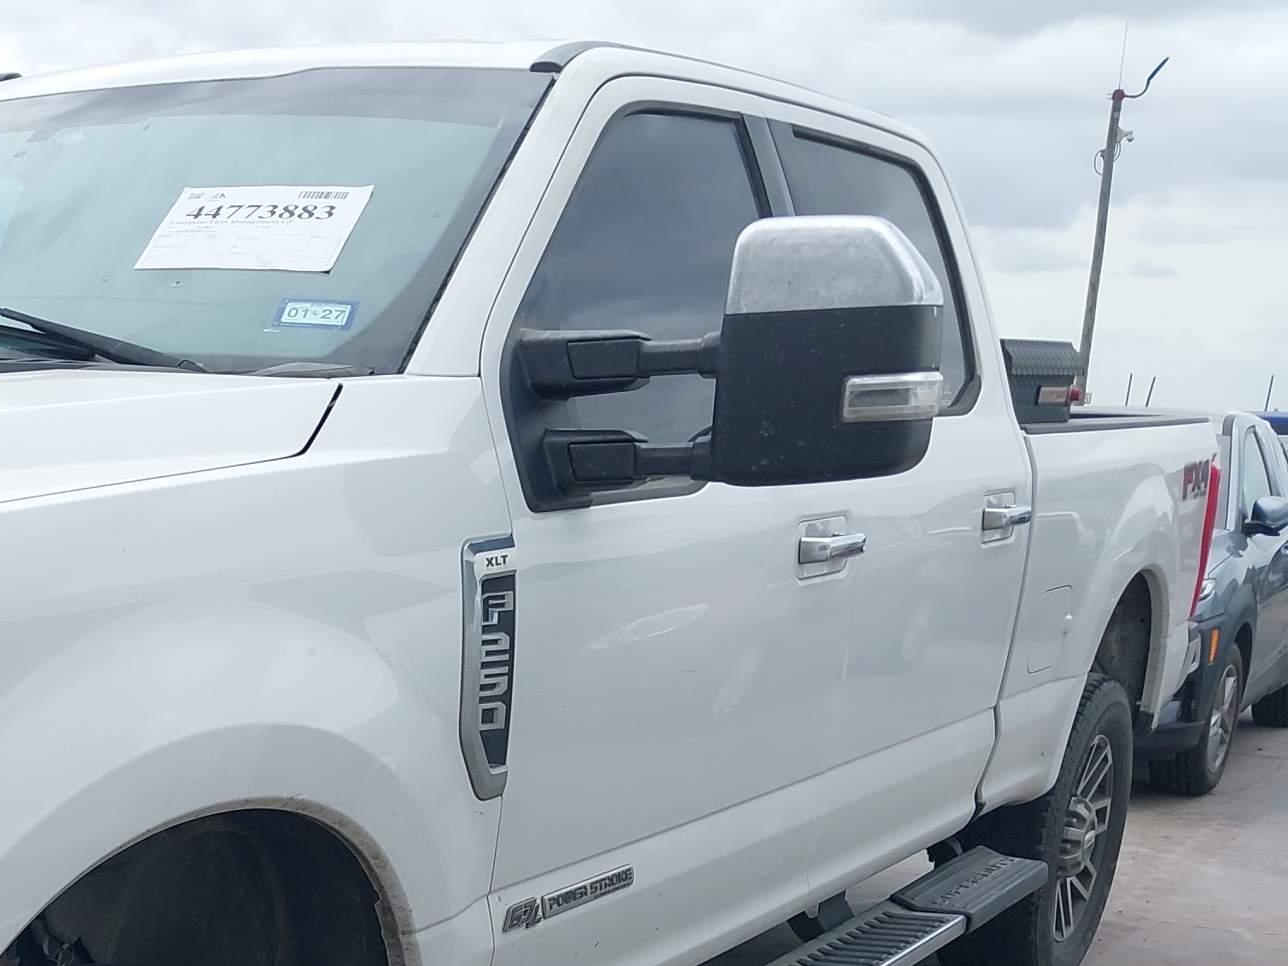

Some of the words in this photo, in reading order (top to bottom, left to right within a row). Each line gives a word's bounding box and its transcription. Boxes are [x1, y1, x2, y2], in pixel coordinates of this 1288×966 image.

[185, 204, 337, 220] 44773883
[287, 307, 309, 319] 01
[320, 308, 347, 320] 27
[485, 554, 509, 568] XLT
[548, 886, 588, 910] POWER
[589, 867, 633, 895] STROKE
